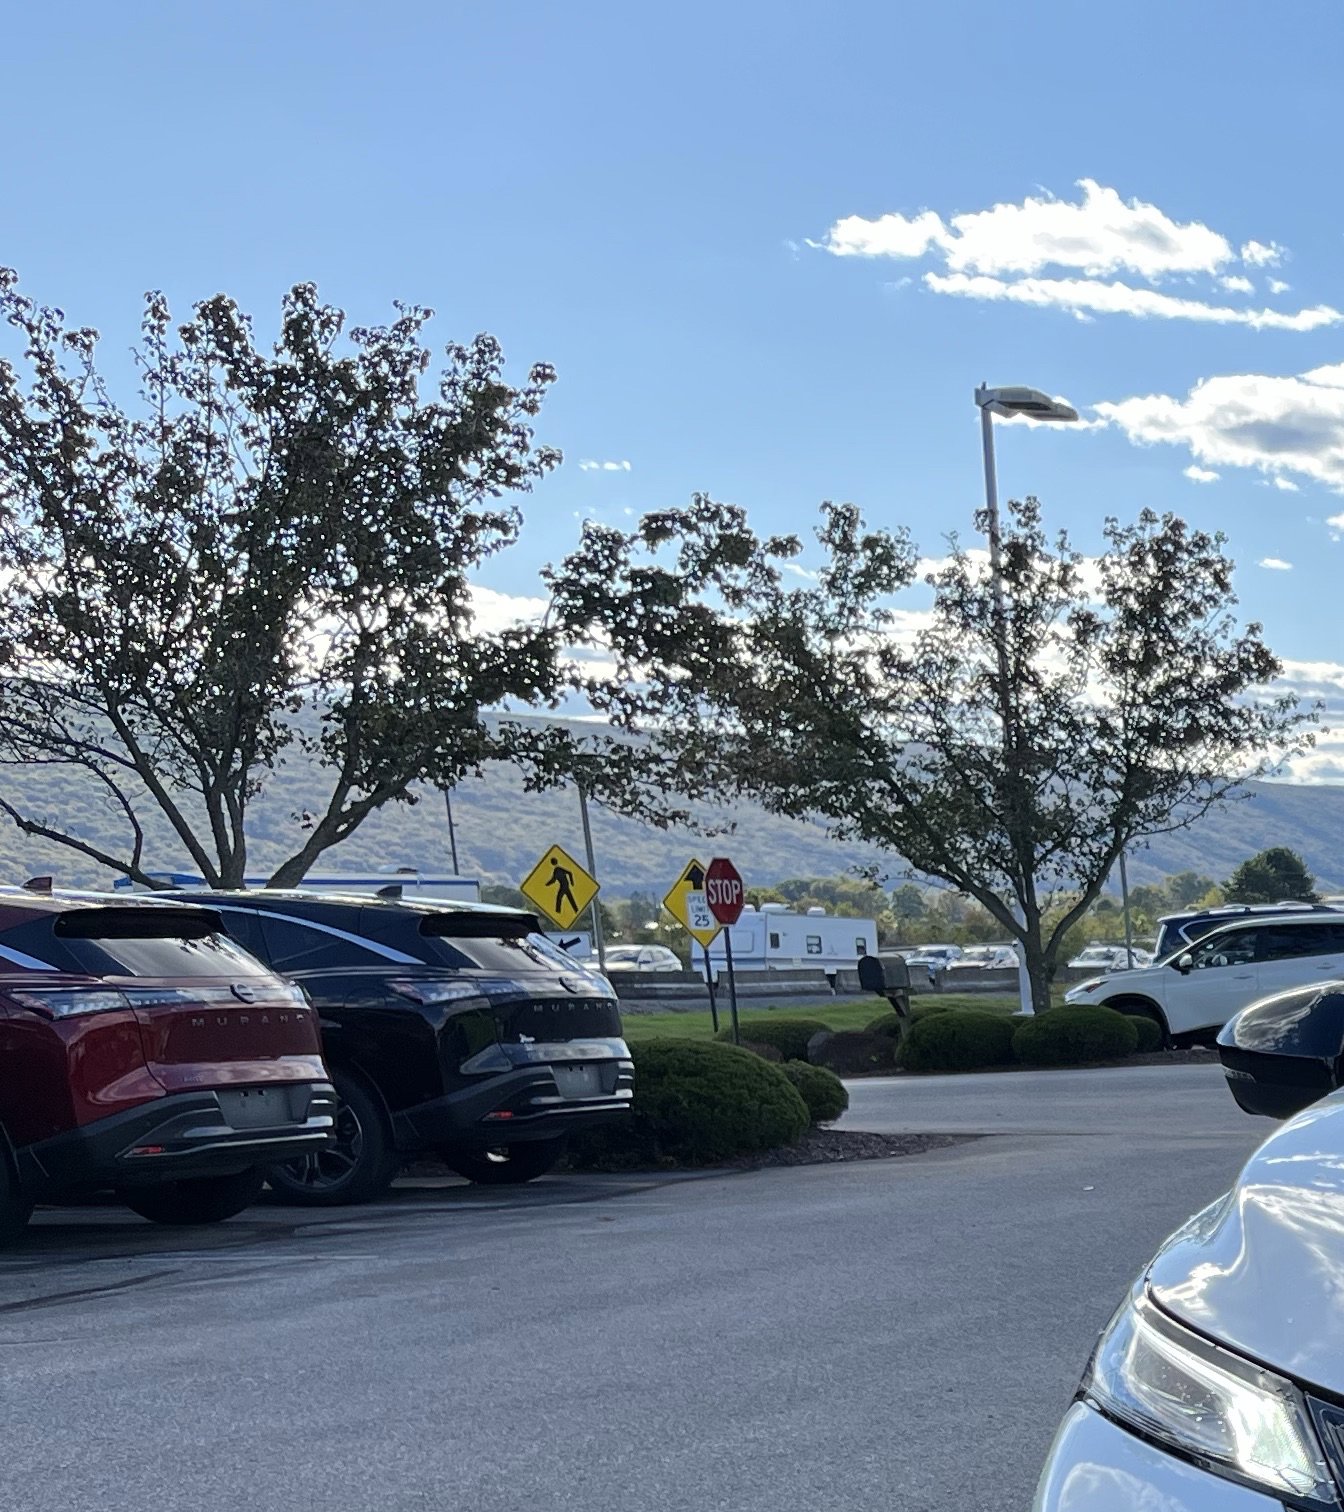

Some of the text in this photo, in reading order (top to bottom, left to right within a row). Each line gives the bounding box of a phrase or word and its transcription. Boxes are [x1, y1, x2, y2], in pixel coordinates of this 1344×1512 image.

[707, 879, 741, 904] STOP
[694, 914, 710, 927] 25
[533, 1002, 613, 1013] MURANO
[191, 1013, 305, 1028] MURANO
